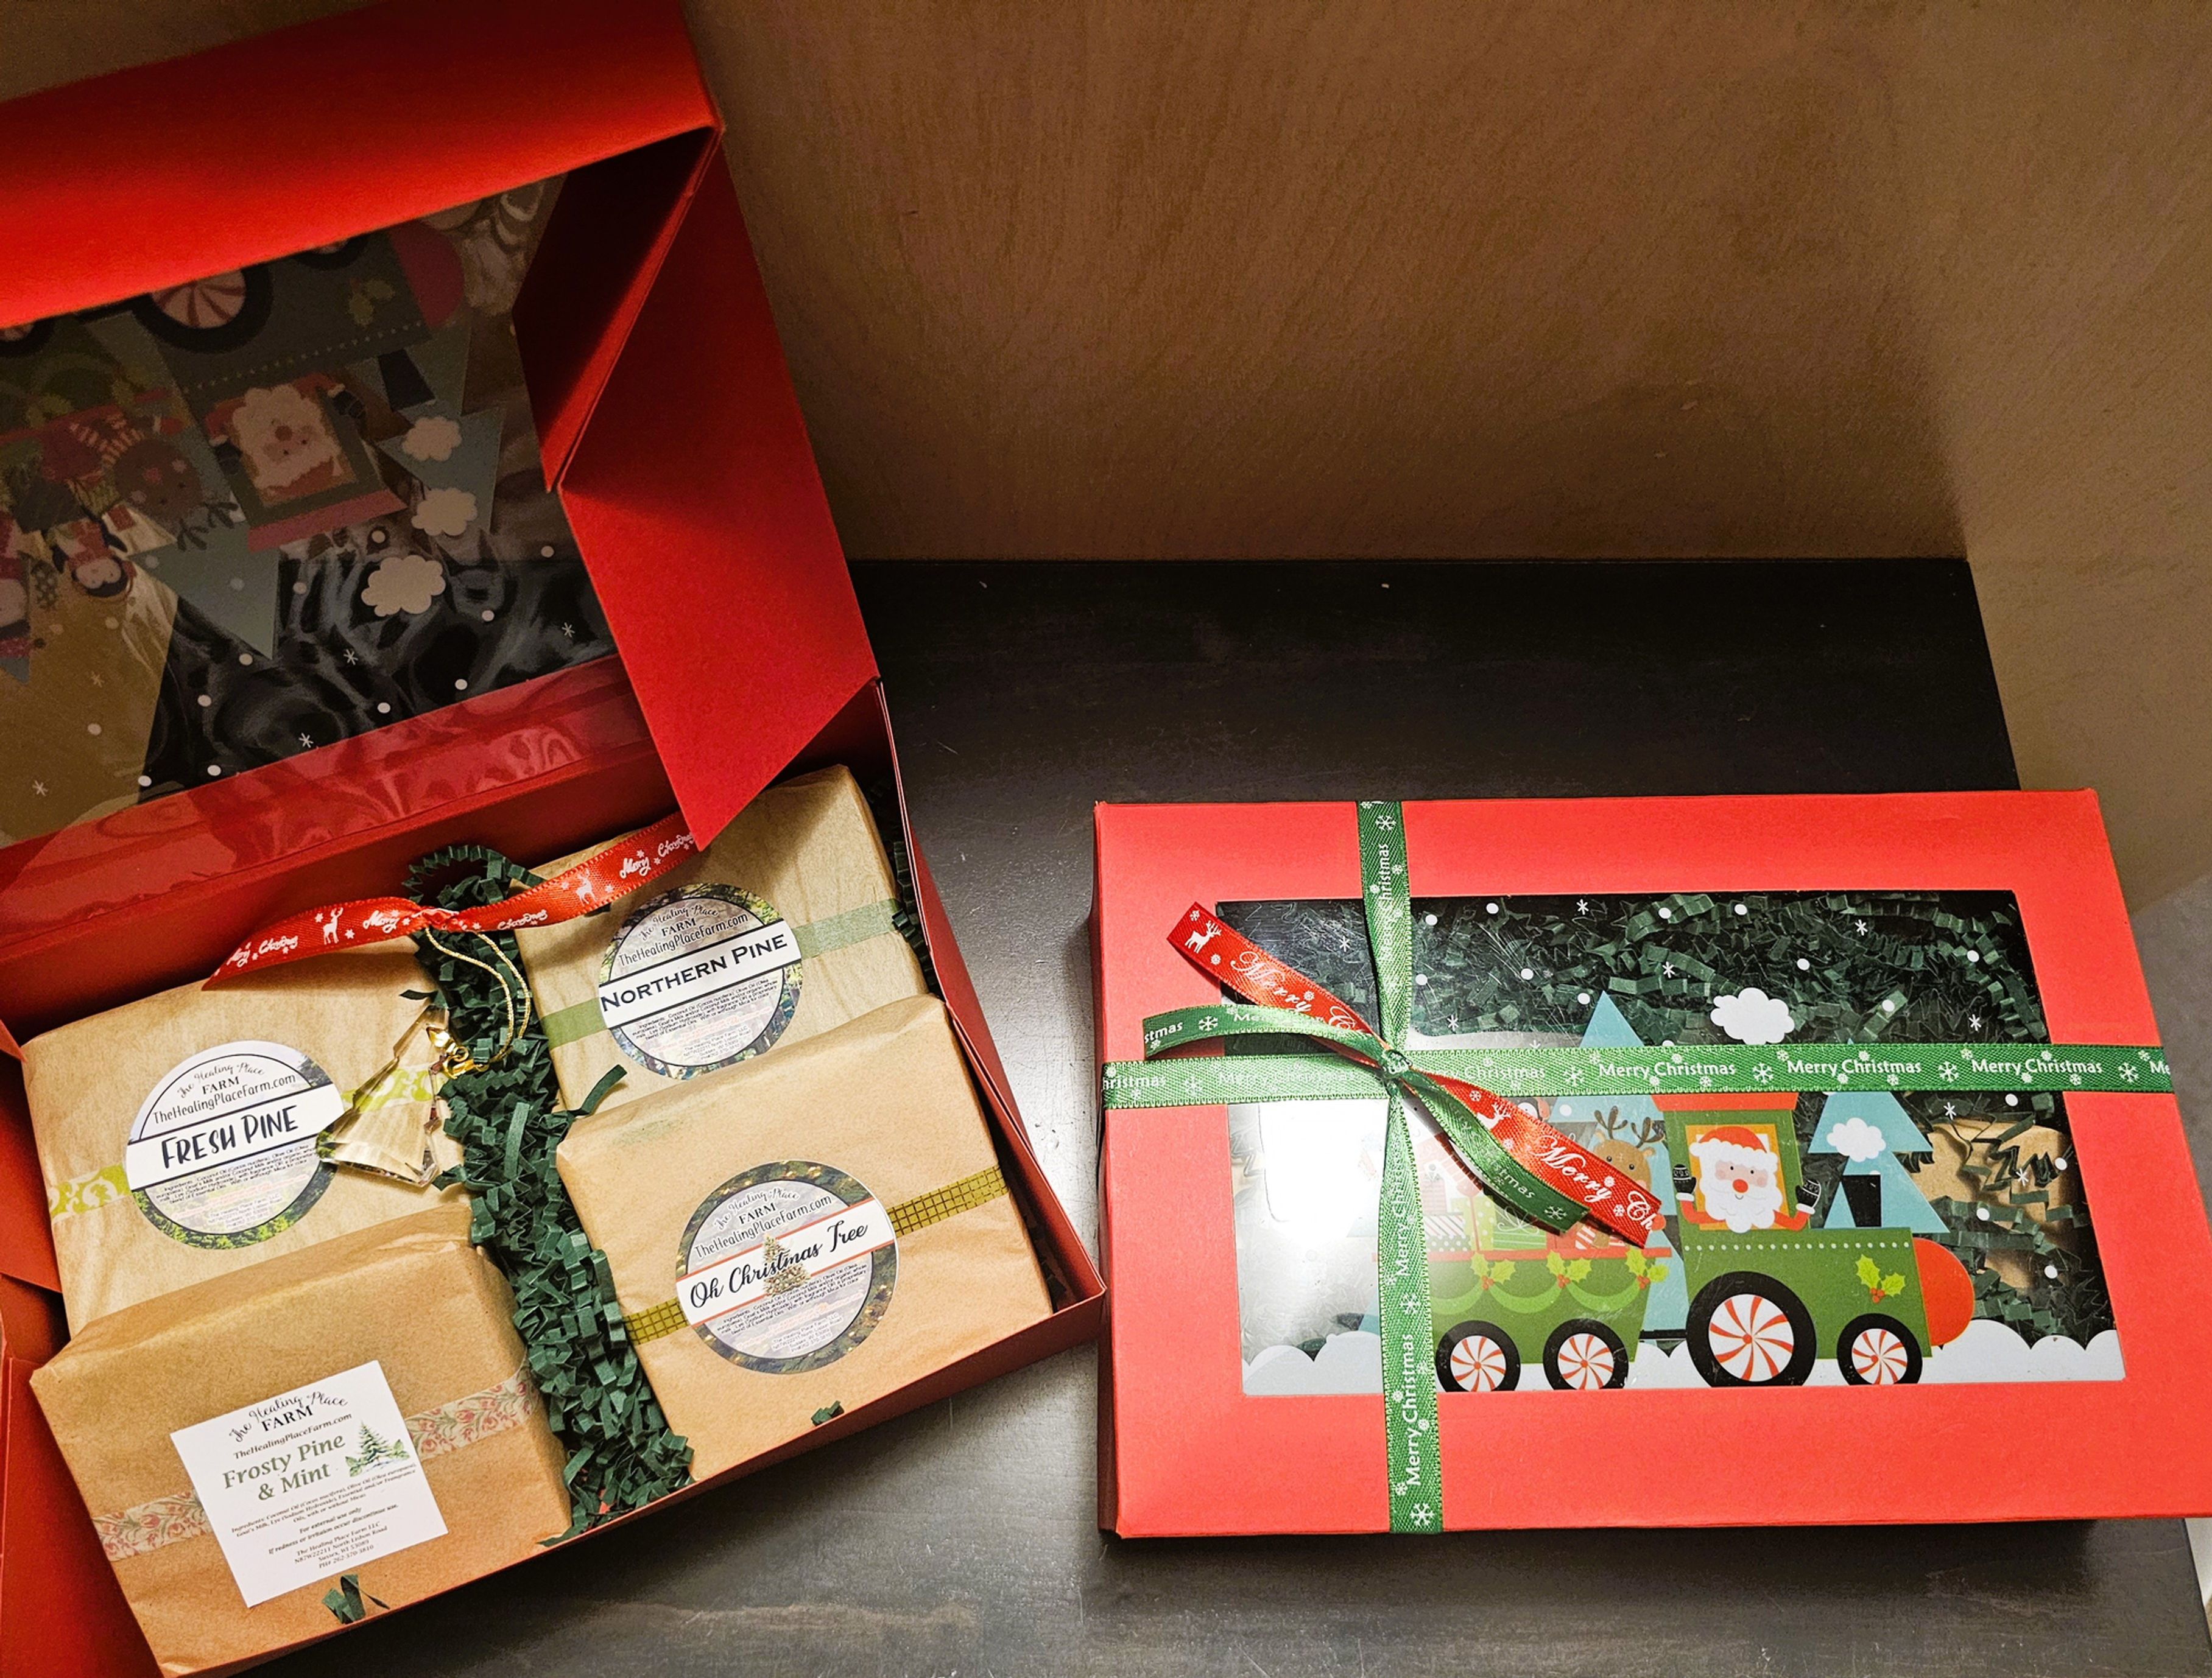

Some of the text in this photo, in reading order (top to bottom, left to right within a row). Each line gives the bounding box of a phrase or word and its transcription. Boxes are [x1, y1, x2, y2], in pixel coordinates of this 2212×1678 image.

[619, 910, 748, 966] TheHealingPlaceFarm.com
[652, 907, 690, 925] Healing
[661, 918, 696, 936] FARM
[601, 934, 787, 1012] NORTHERN PINE
[177, 1083, 194, 1099] The
[194, 1063, 234, 1083] Healing
[202, 1076, 239, 1094] FARM
[1599, 1063, 1649, 1082] Merry
[1654, 1061, 1736, 1076] Christmas
[1787, 1059, 1837, 1079] Merry
[1841, 1057, 1921, 1075] Christmas
[1971, 1058, 2021, 1079] Merry
[2025, 1056, 2102, 1075] Christmas
[153, 1075, 295, 1124] TheHealingPlaceFarm.com
[161, 1125, 236, 1169] FRESH
[241, 1105, 298, 1144] PINE
[1529, 1134, 1613, 1202] Merry
[728, 1190, 767, 1213] Healing
[739, 1202, 775, 1224] FARM
[695, 1196, 831, 1257] TheHealingPlaceFarm.com
[1395, 1222, 1409, 1277] Merry
[691, 1277, 724, 1308] Oh
[729, 1244, 823, 1293] Christmas
[827, 1220, 868, 1252] Tree
[229, 1392, 348, 1442] The Healing Place
[261, 1405, 312, 1431] FARM
[1401, 1333, 1422, 1486] Merry Christmas
[235, 1414, 351, 1459] TheHealingPlaceFarm.com
[223, 1436, 345, 1489] Frosty Pine
[258, 1464, 330, 1500] & Mint
